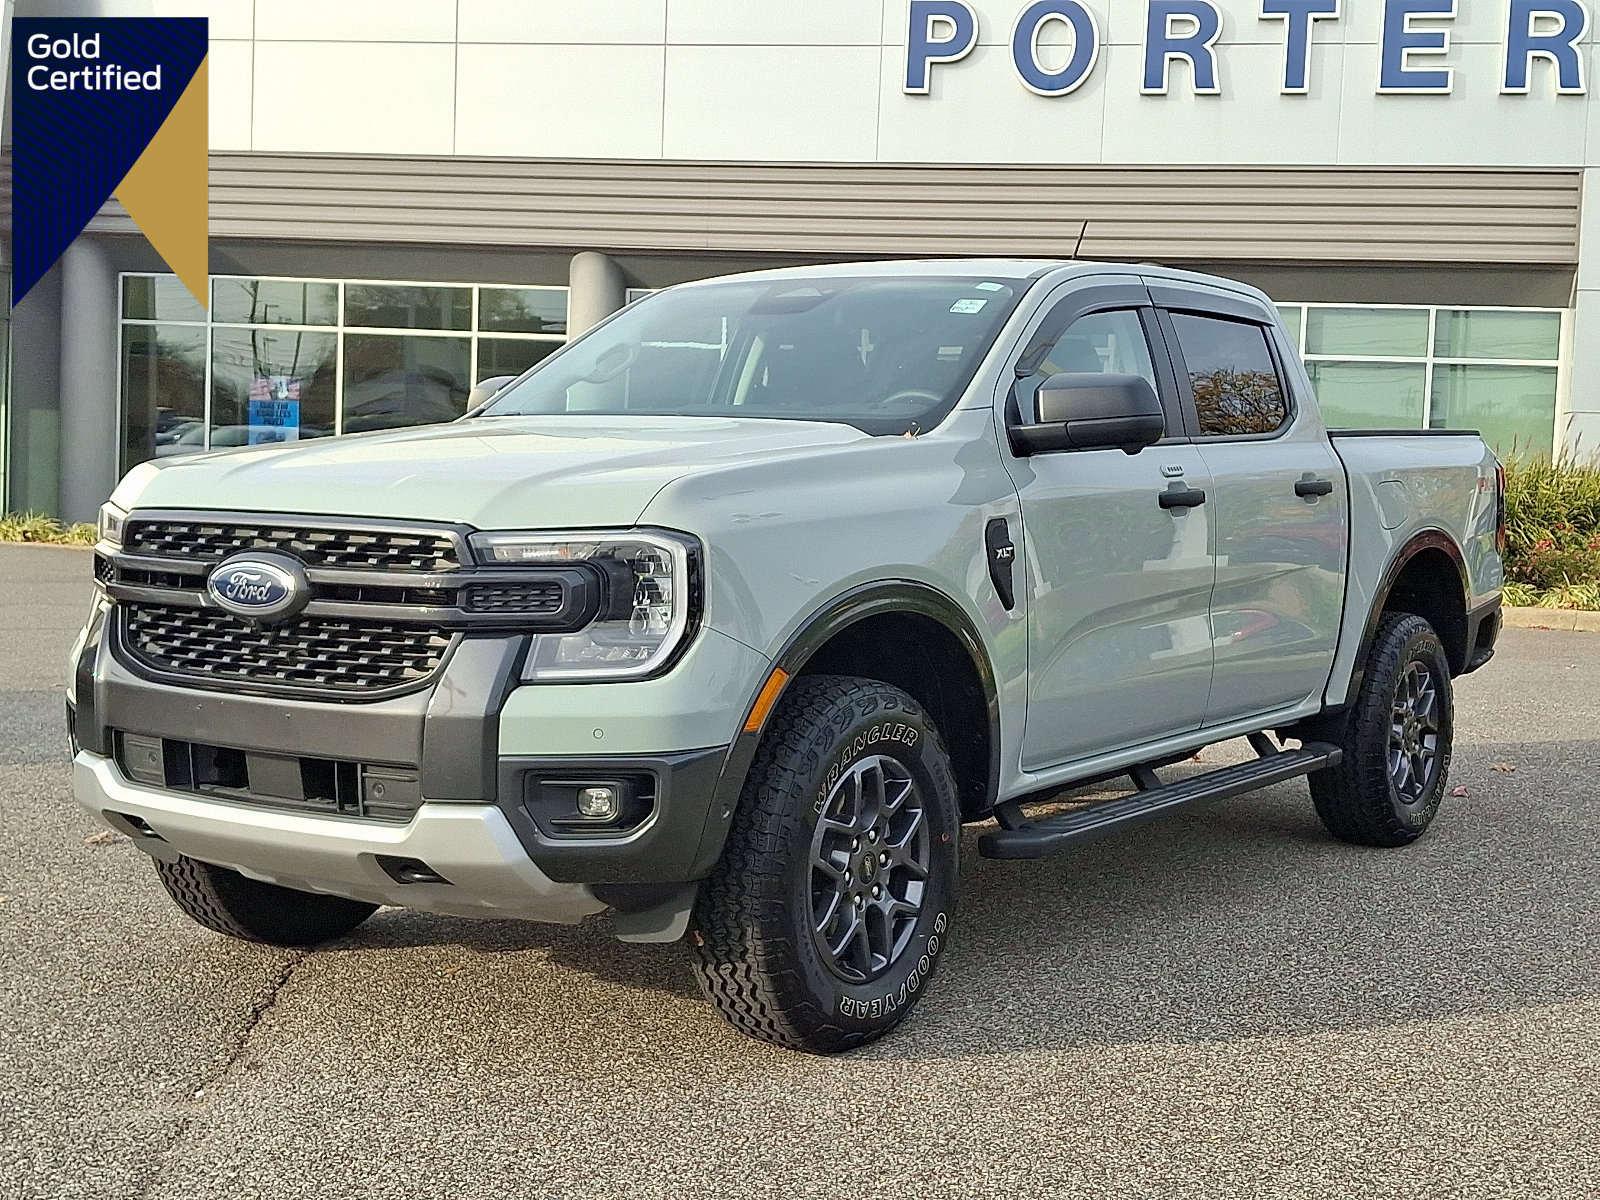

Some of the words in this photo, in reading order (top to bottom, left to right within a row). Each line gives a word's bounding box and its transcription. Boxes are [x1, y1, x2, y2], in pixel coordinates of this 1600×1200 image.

[902, 0, 1590, 96] PORTER
[226, 571, 272, 601] Ford
[996, 546, 1014, 560] XLT
[813, 722, 919, 815] WRANGLER
[840, 912, 947, 1019] GOODYEAR
